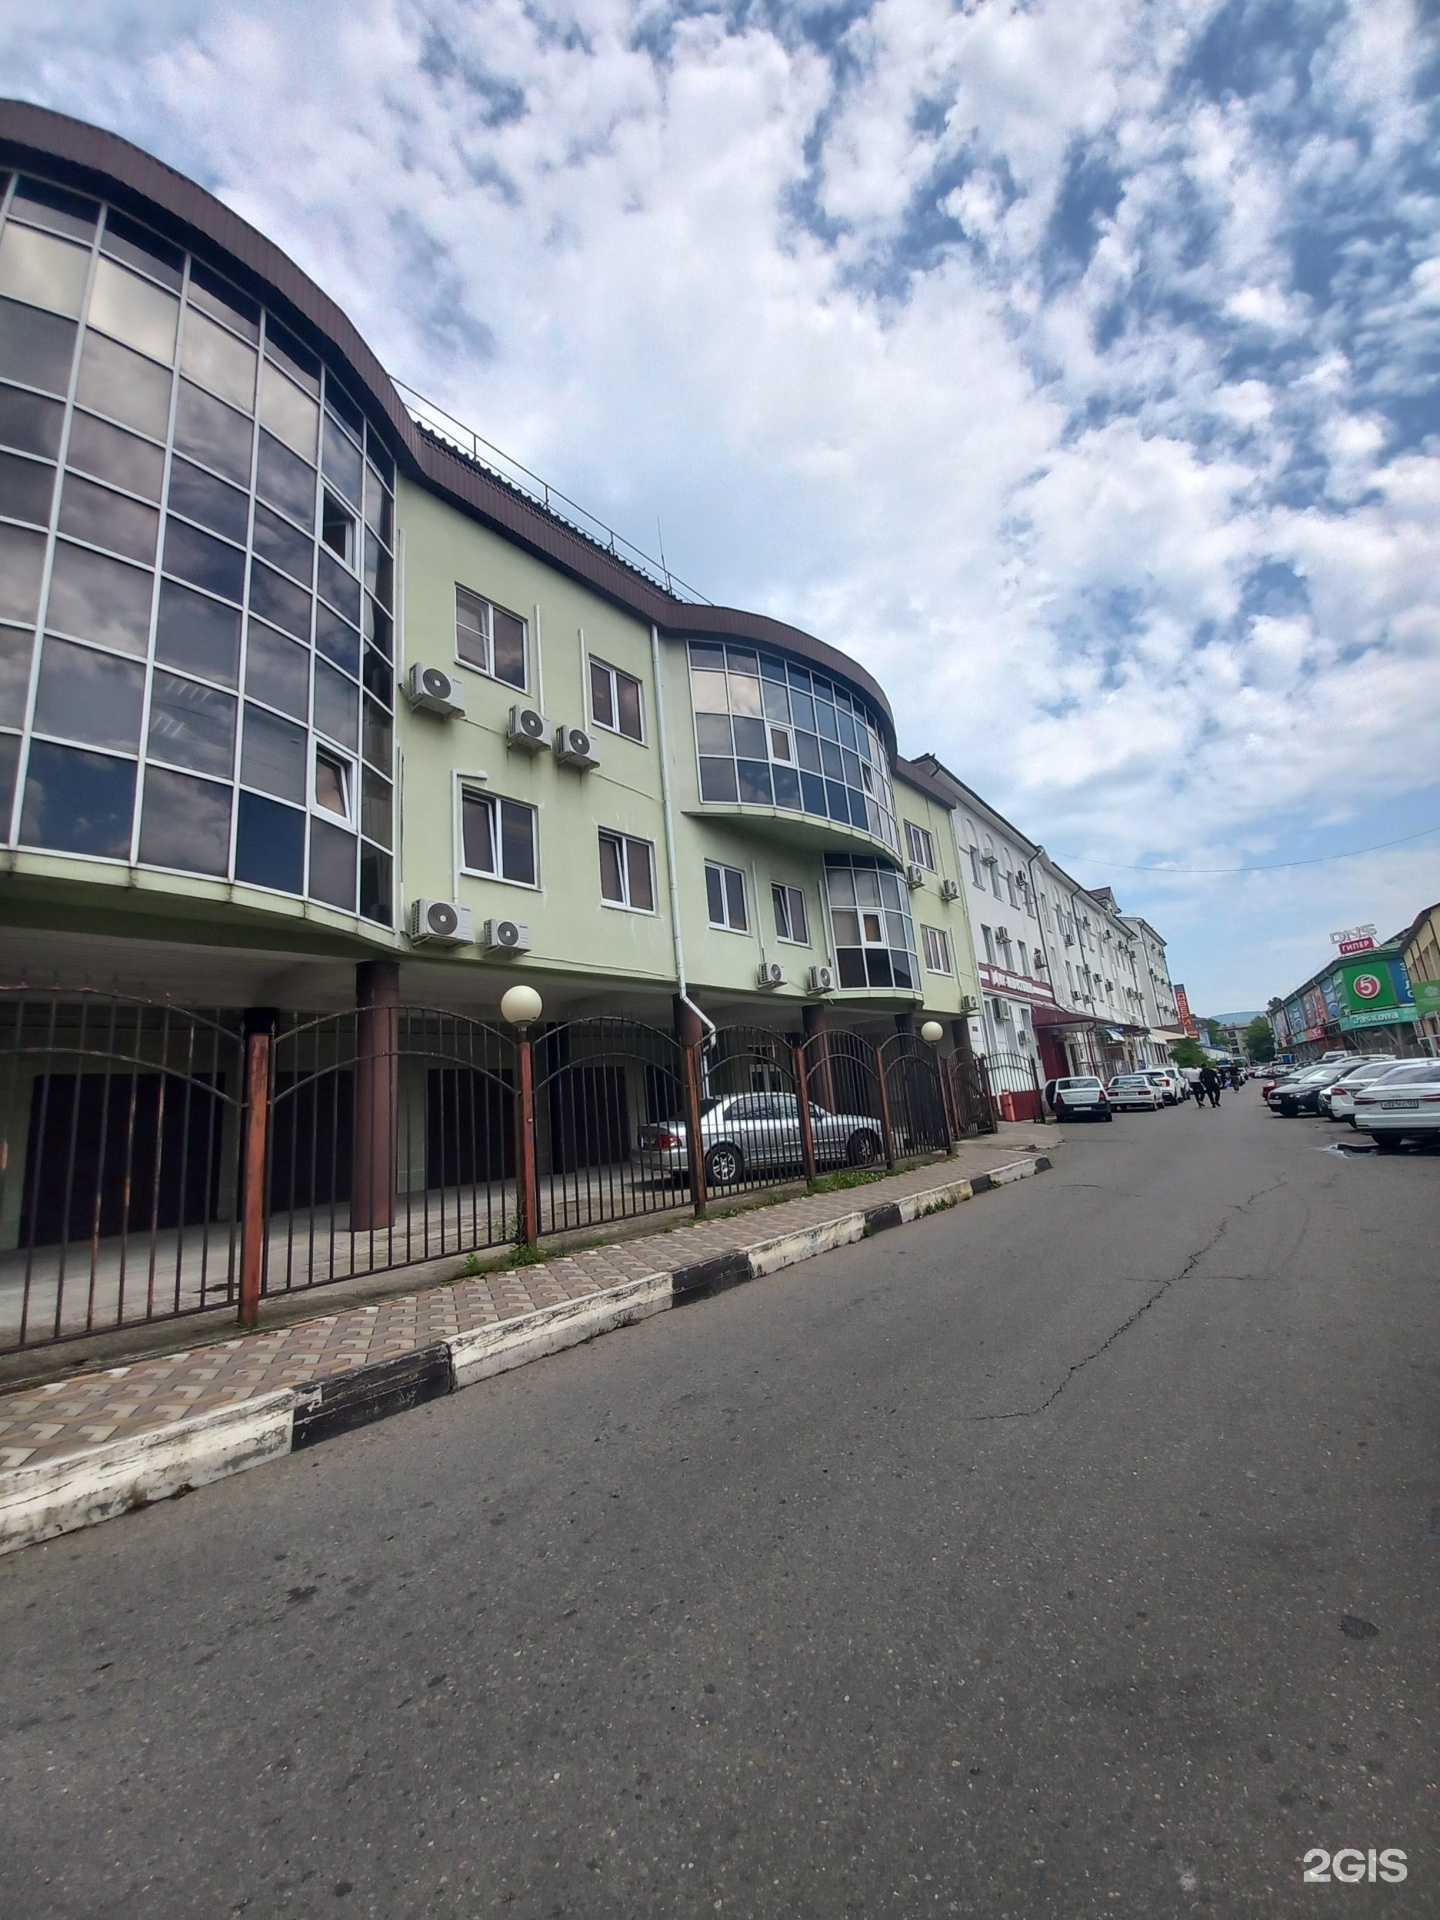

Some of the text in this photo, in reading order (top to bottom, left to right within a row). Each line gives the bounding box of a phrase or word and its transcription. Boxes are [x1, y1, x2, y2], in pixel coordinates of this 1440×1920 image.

[1329, 923, 1377, 944] DNS
[1341, 939, 1370, 952] ГИПЕР
[1360, 975, 1374, 994] 5
